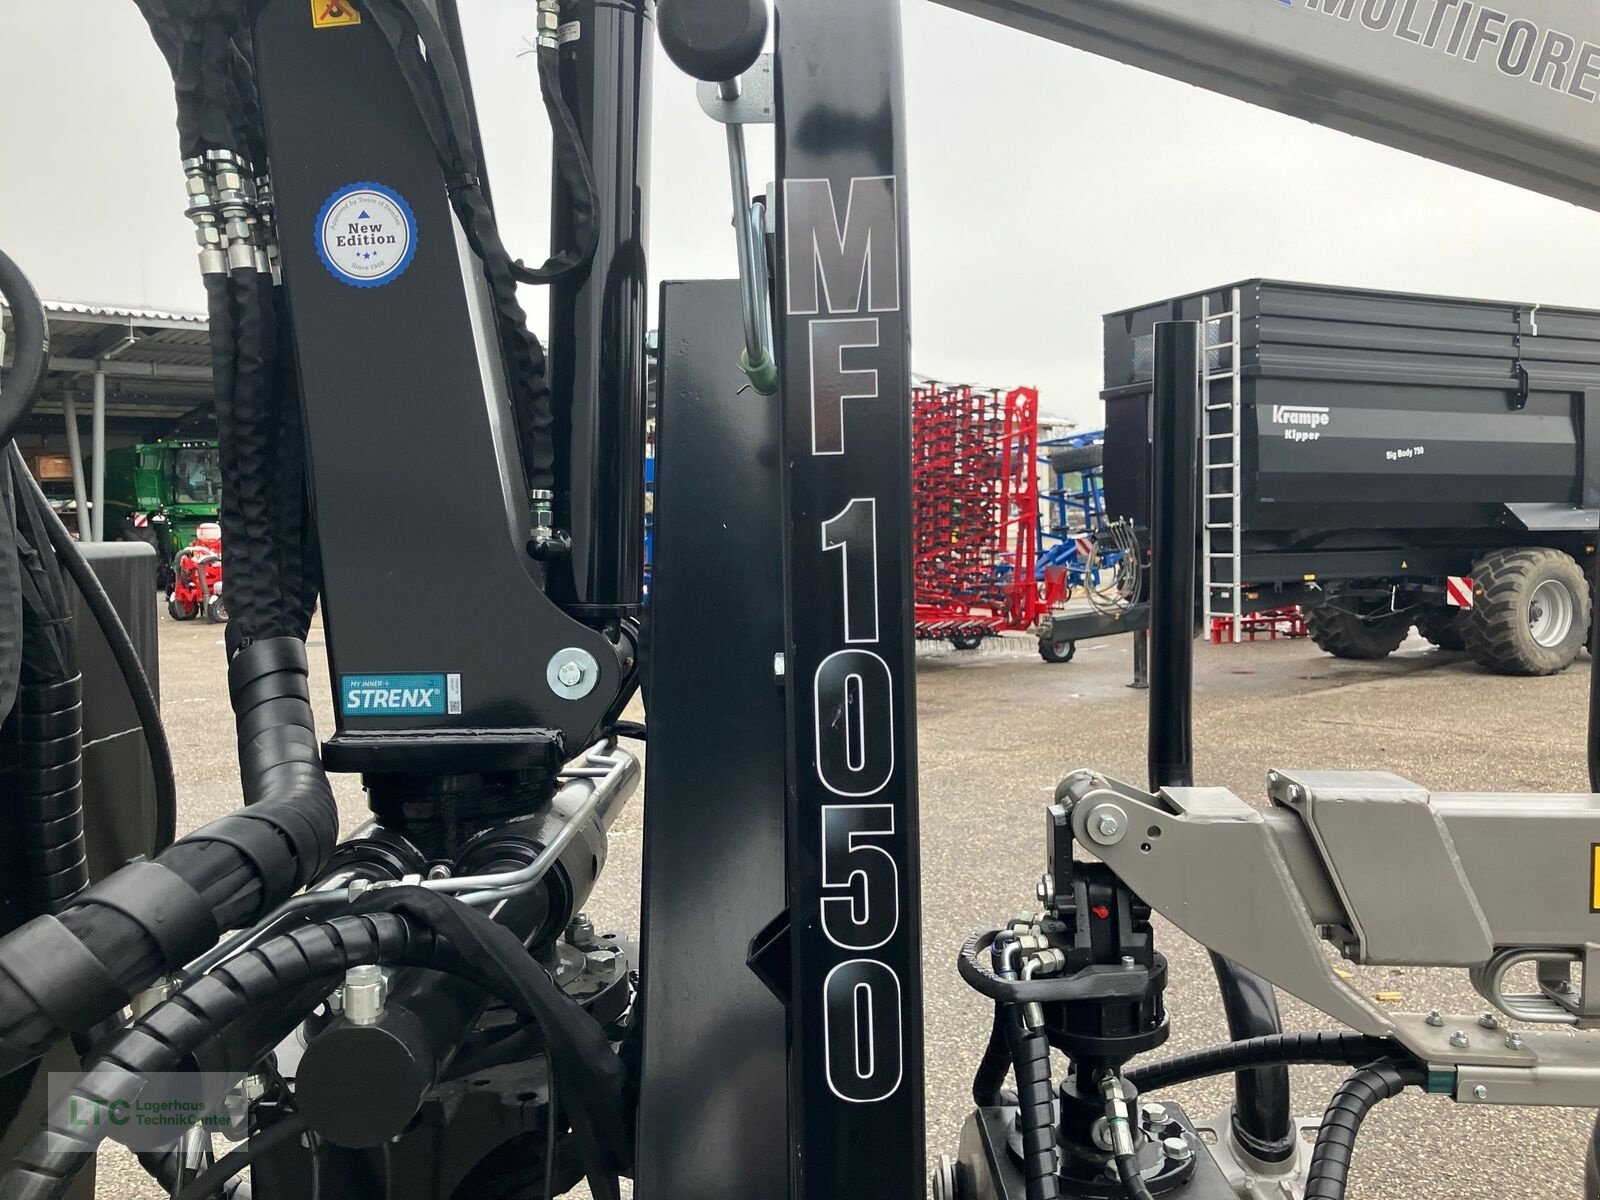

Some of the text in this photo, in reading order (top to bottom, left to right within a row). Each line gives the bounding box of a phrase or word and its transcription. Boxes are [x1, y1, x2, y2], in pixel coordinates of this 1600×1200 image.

[348, 223, 382, 234] New
[336, 233, 396, 247] Edition
[1272, 404, 1330, 428] Krampe
[1284, 429, 1321, 442] Kipper
[1385, 450, 1397, 461] Big
[1397, 447, 1413, 459] Body
[783, 175, 903, 1103] MF 1050
